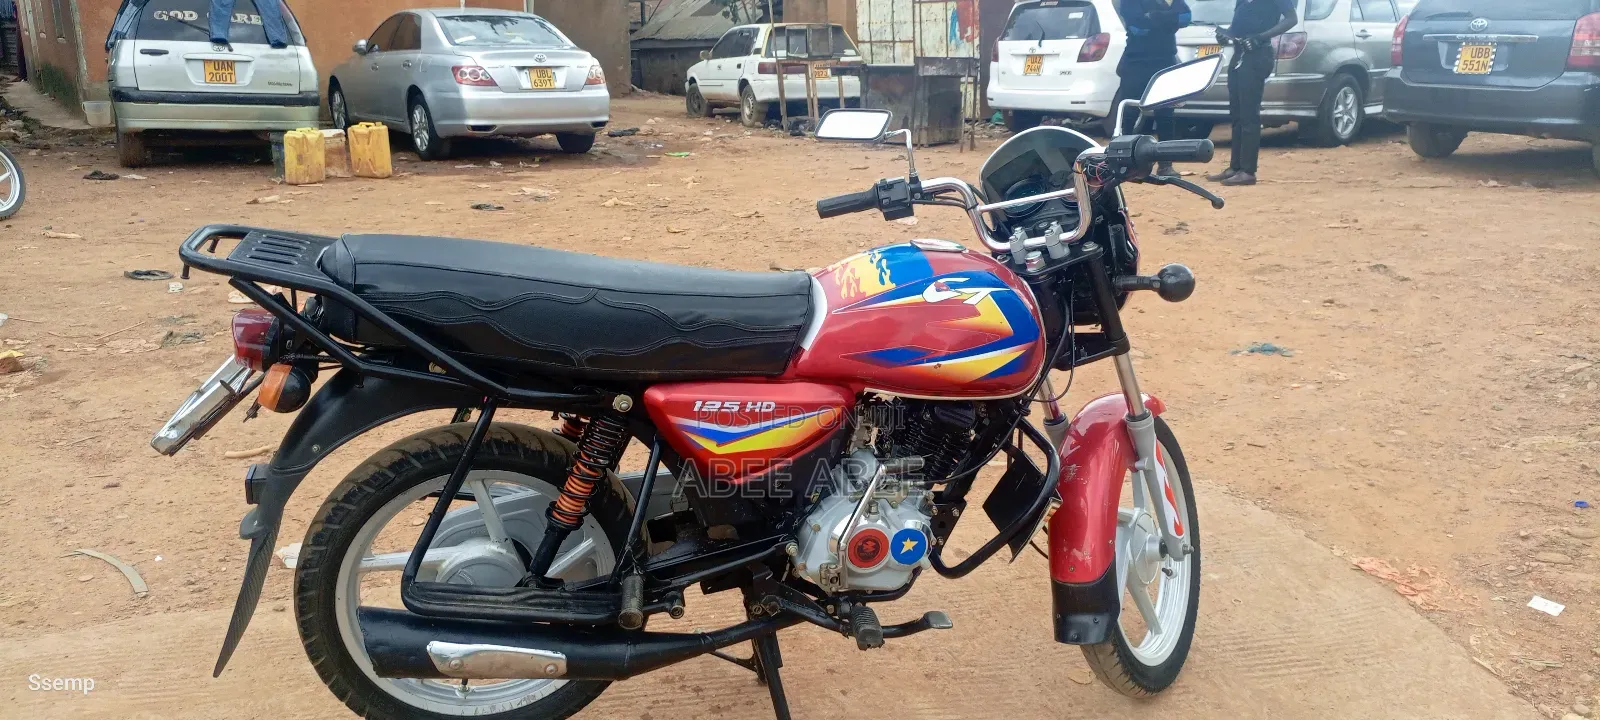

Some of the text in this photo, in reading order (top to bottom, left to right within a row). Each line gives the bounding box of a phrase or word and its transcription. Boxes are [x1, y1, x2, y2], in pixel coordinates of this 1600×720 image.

[154, 10, 198, 21] GOD
[1470, 47, 1491, 59] UBB
[213, 60, 233, 71] UAN
[1461, 60, 1488, 72] 551N
[208, 72, 234, 82] 200T
[536, 69, 552, 78] UBL
[533, 78, 553, 88] 639T
[693, 400, 776, 413] 125 HD
